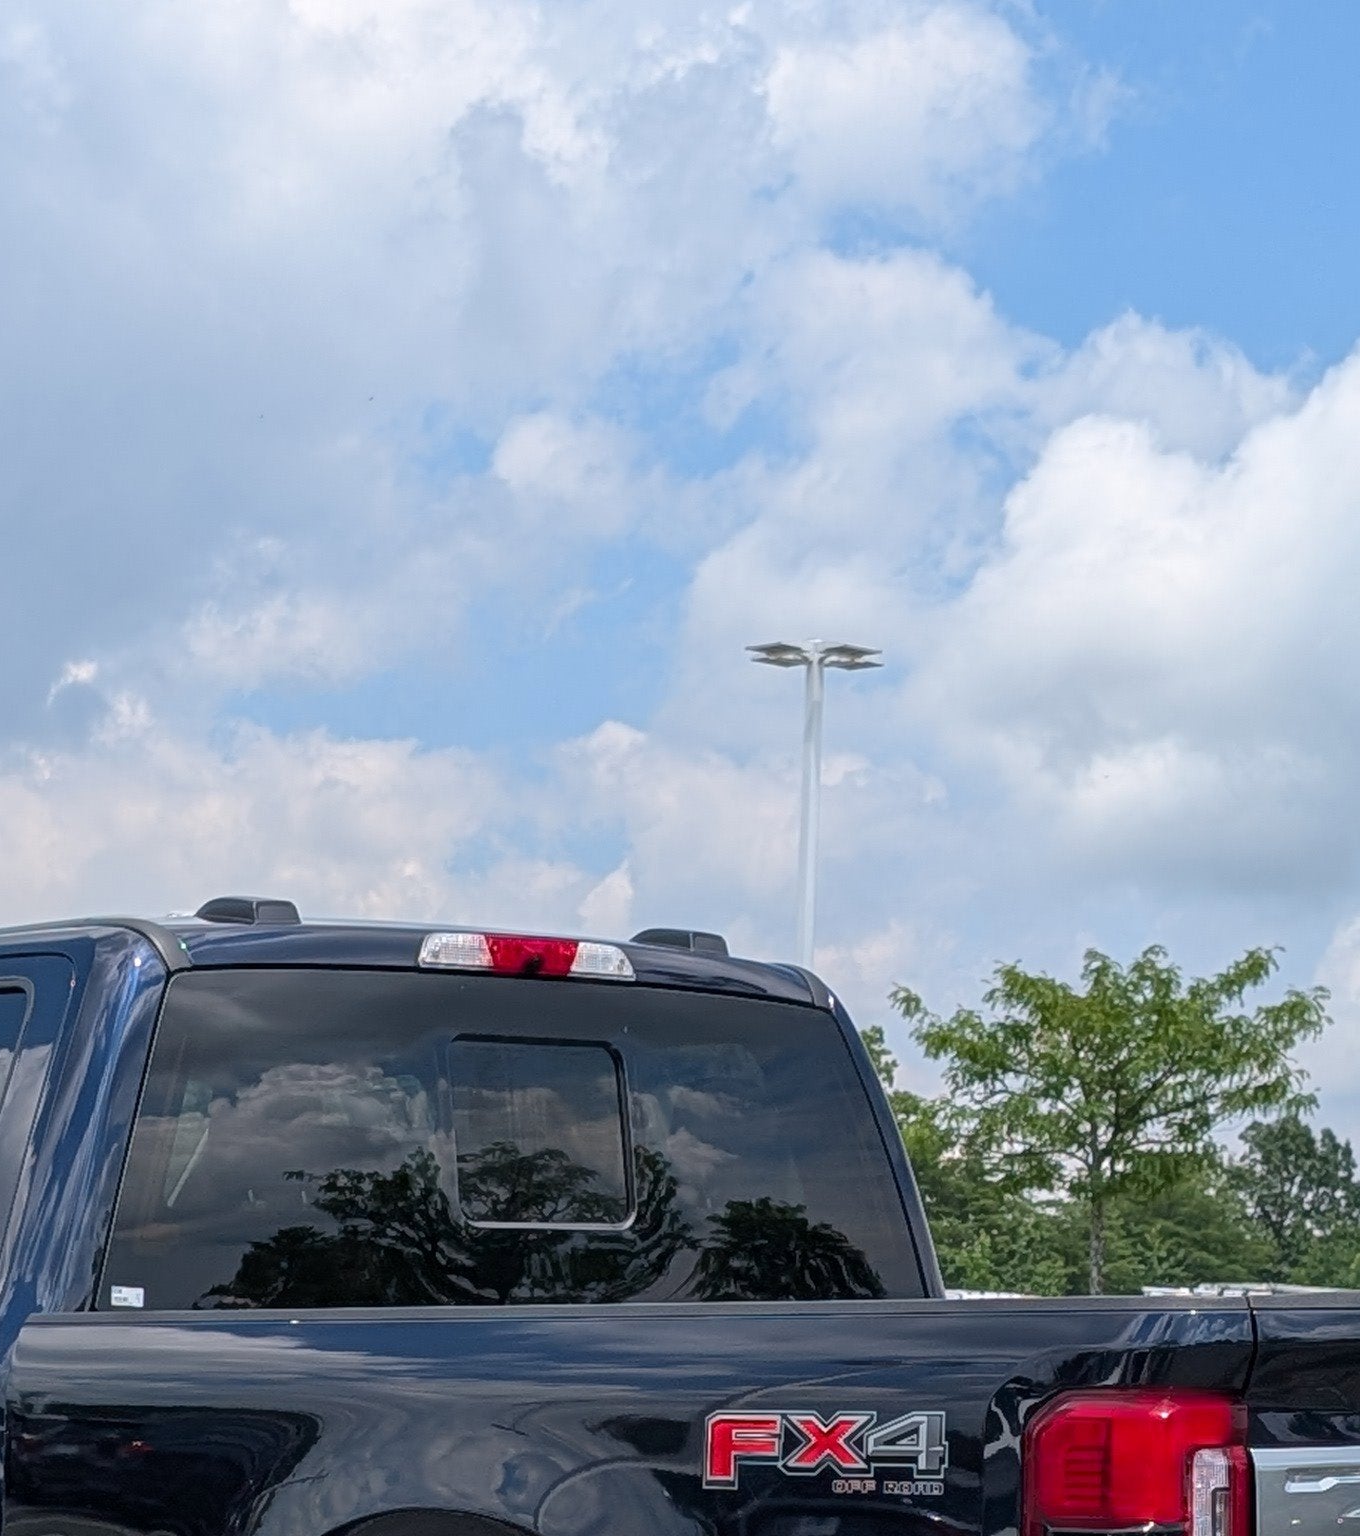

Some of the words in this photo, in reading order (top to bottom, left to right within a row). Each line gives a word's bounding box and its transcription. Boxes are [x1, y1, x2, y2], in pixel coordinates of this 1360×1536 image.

[702, 1410, 948, 1490] FX4
[832, 1480, 876, 1495] OFF
[883, 1479, 944, 1496] ROAD
